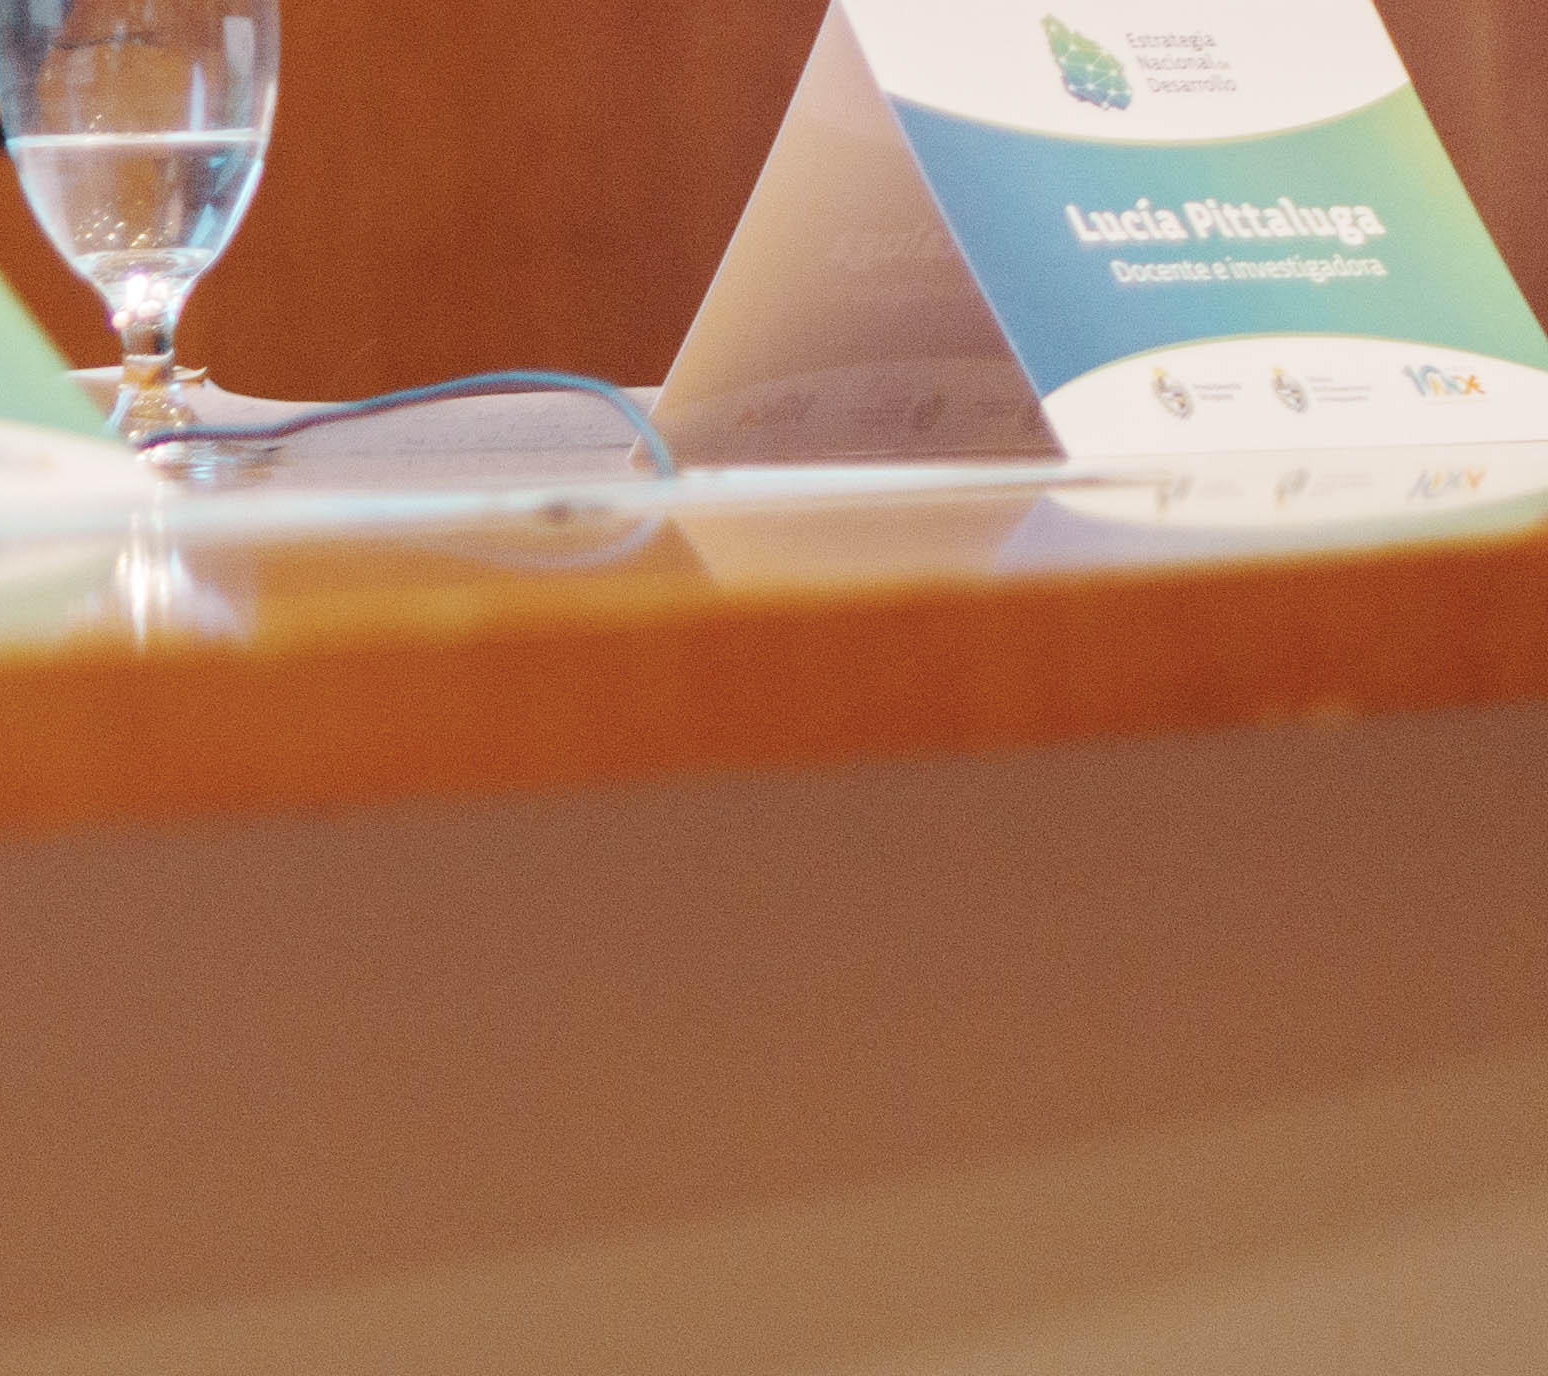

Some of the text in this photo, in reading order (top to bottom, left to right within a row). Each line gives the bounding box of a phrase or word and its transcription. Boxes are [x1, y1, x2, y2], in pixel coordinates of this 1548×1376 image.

[1182, 196, 1387, 246] Pittaluga
[1110, 259, 1211, 283] Docente
[1225, 253, 1389, 284] investigadora
